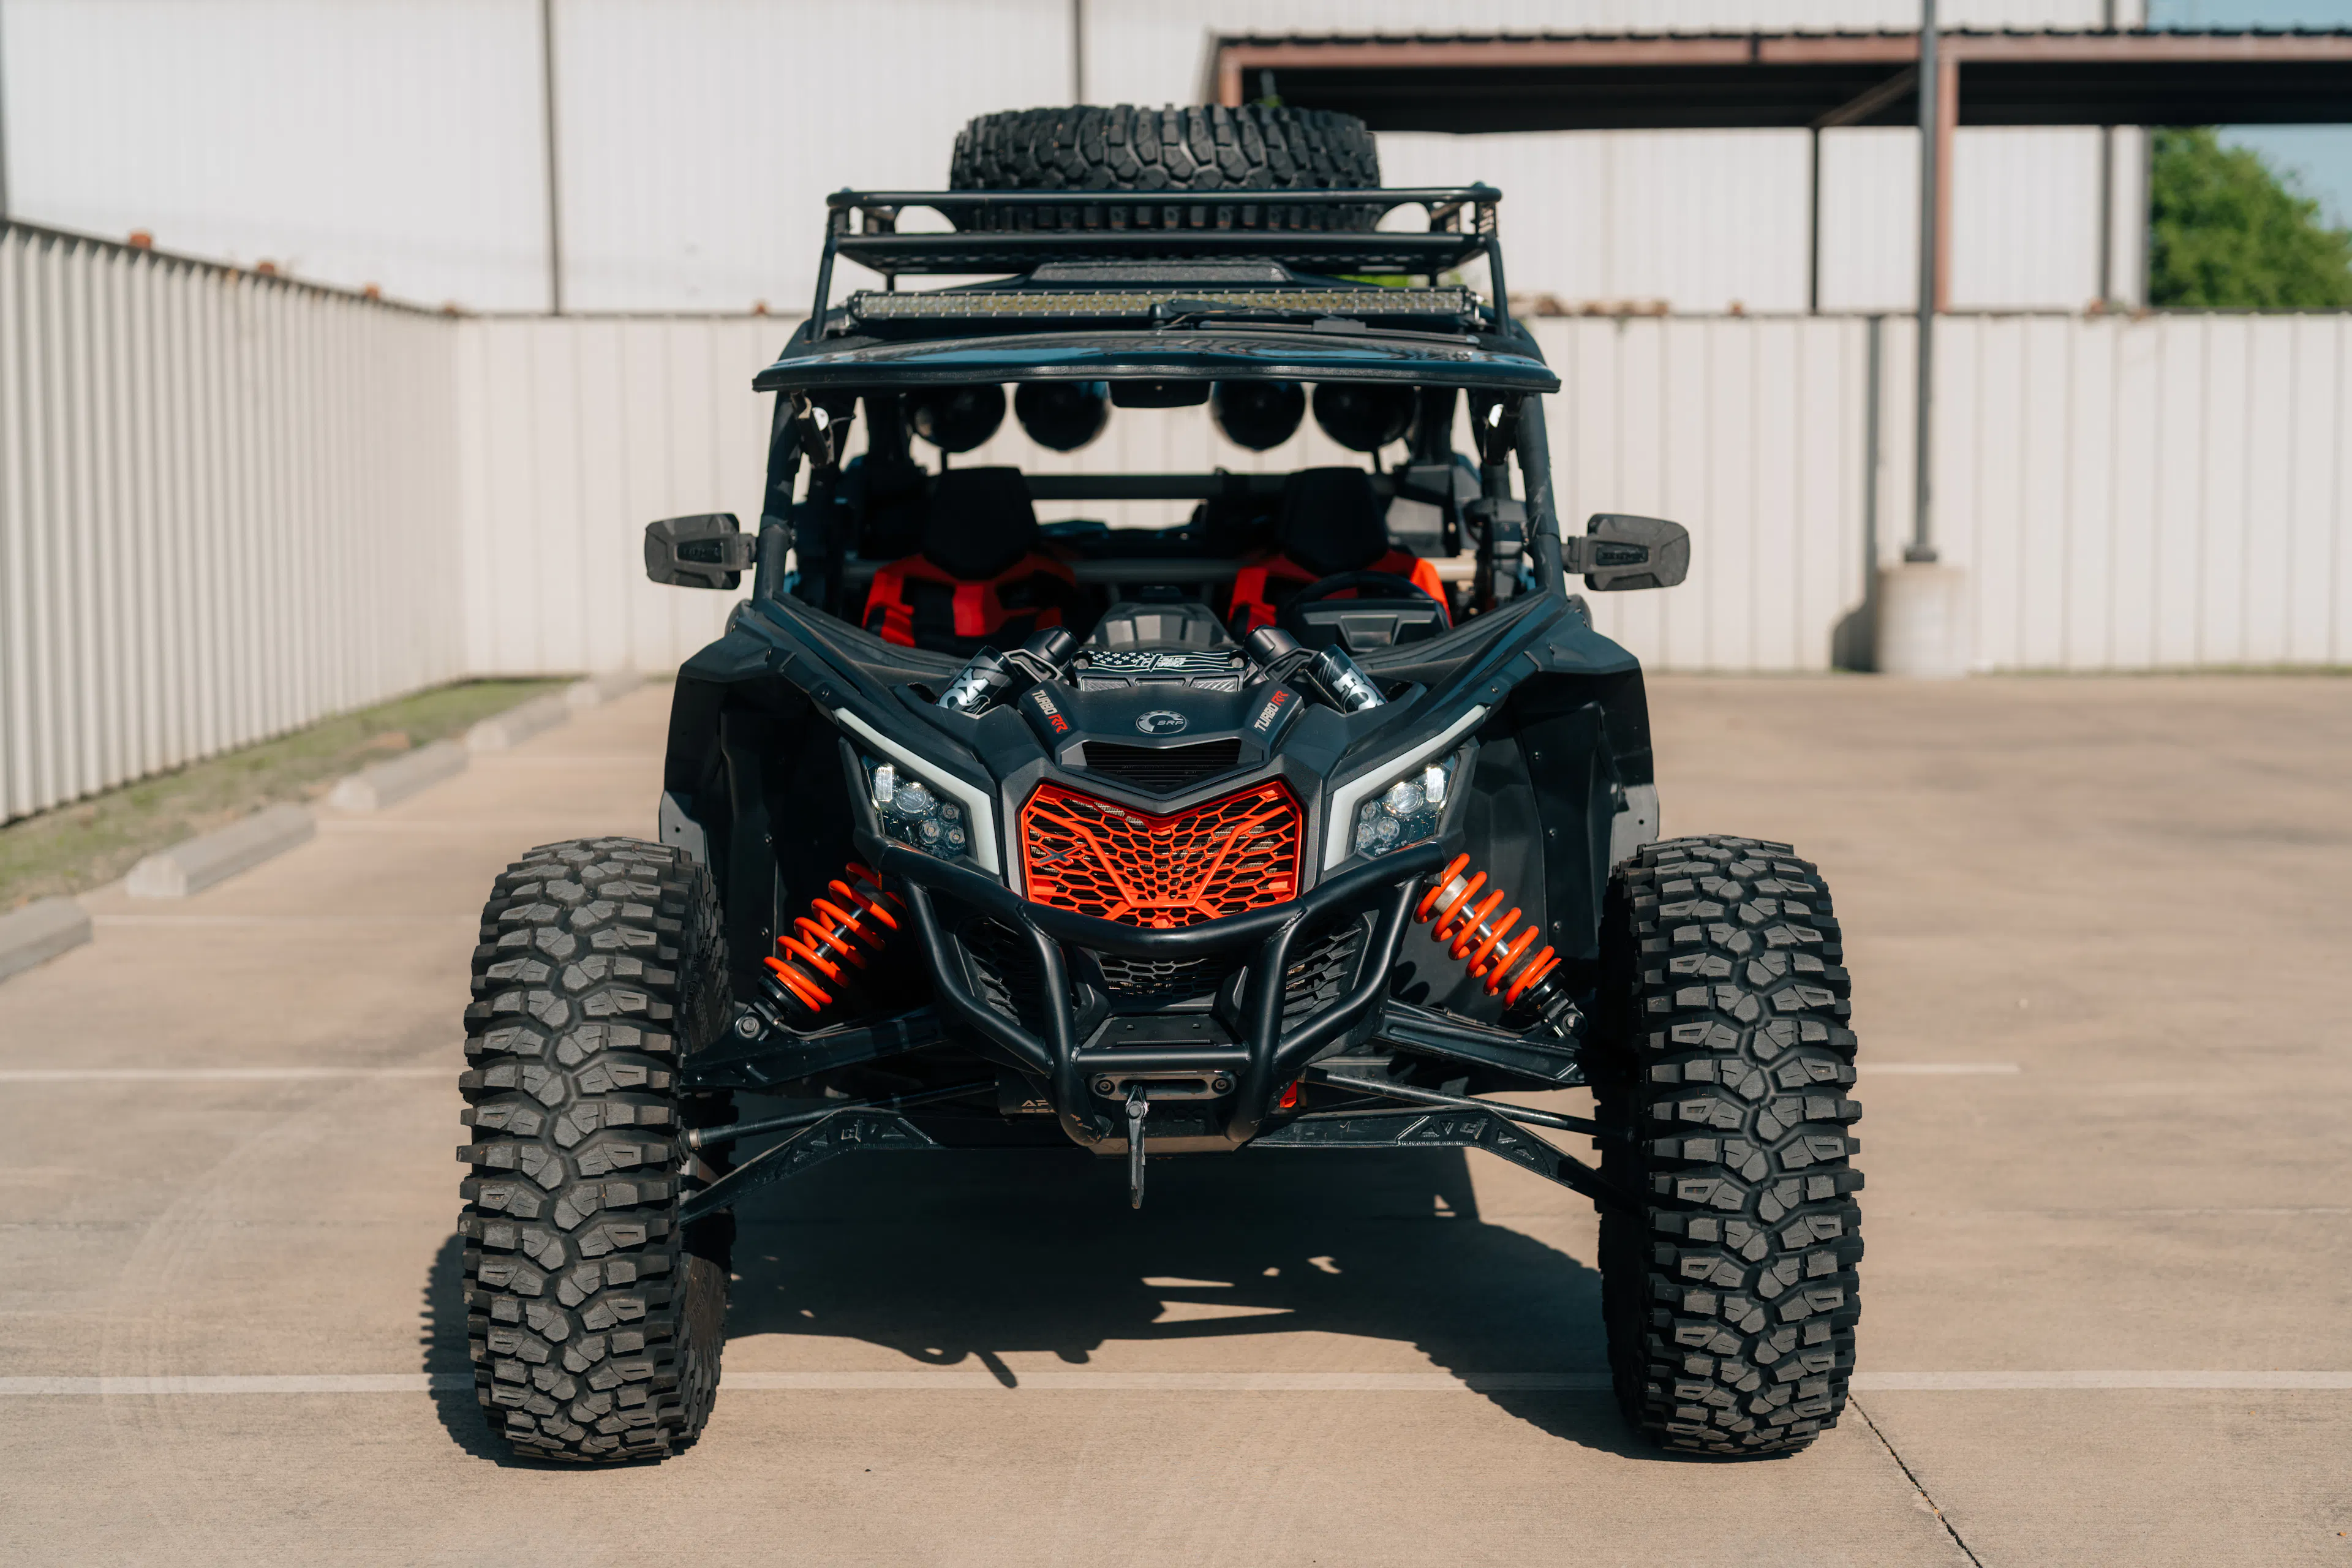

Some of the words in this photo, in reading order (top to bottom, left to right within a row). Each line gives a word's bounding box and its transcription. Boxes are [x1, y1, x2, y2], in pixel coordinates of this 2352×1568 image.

[936, 668, 991, 715] OX
[1031, 690, 1058, 715] TURBO
[1048, 714, 1068, 733] RR
[1254, 702, 1279, 731] TURBO
[1271, 690, 1289, 706] RR
[1332, 667, 1385, 714] FO
